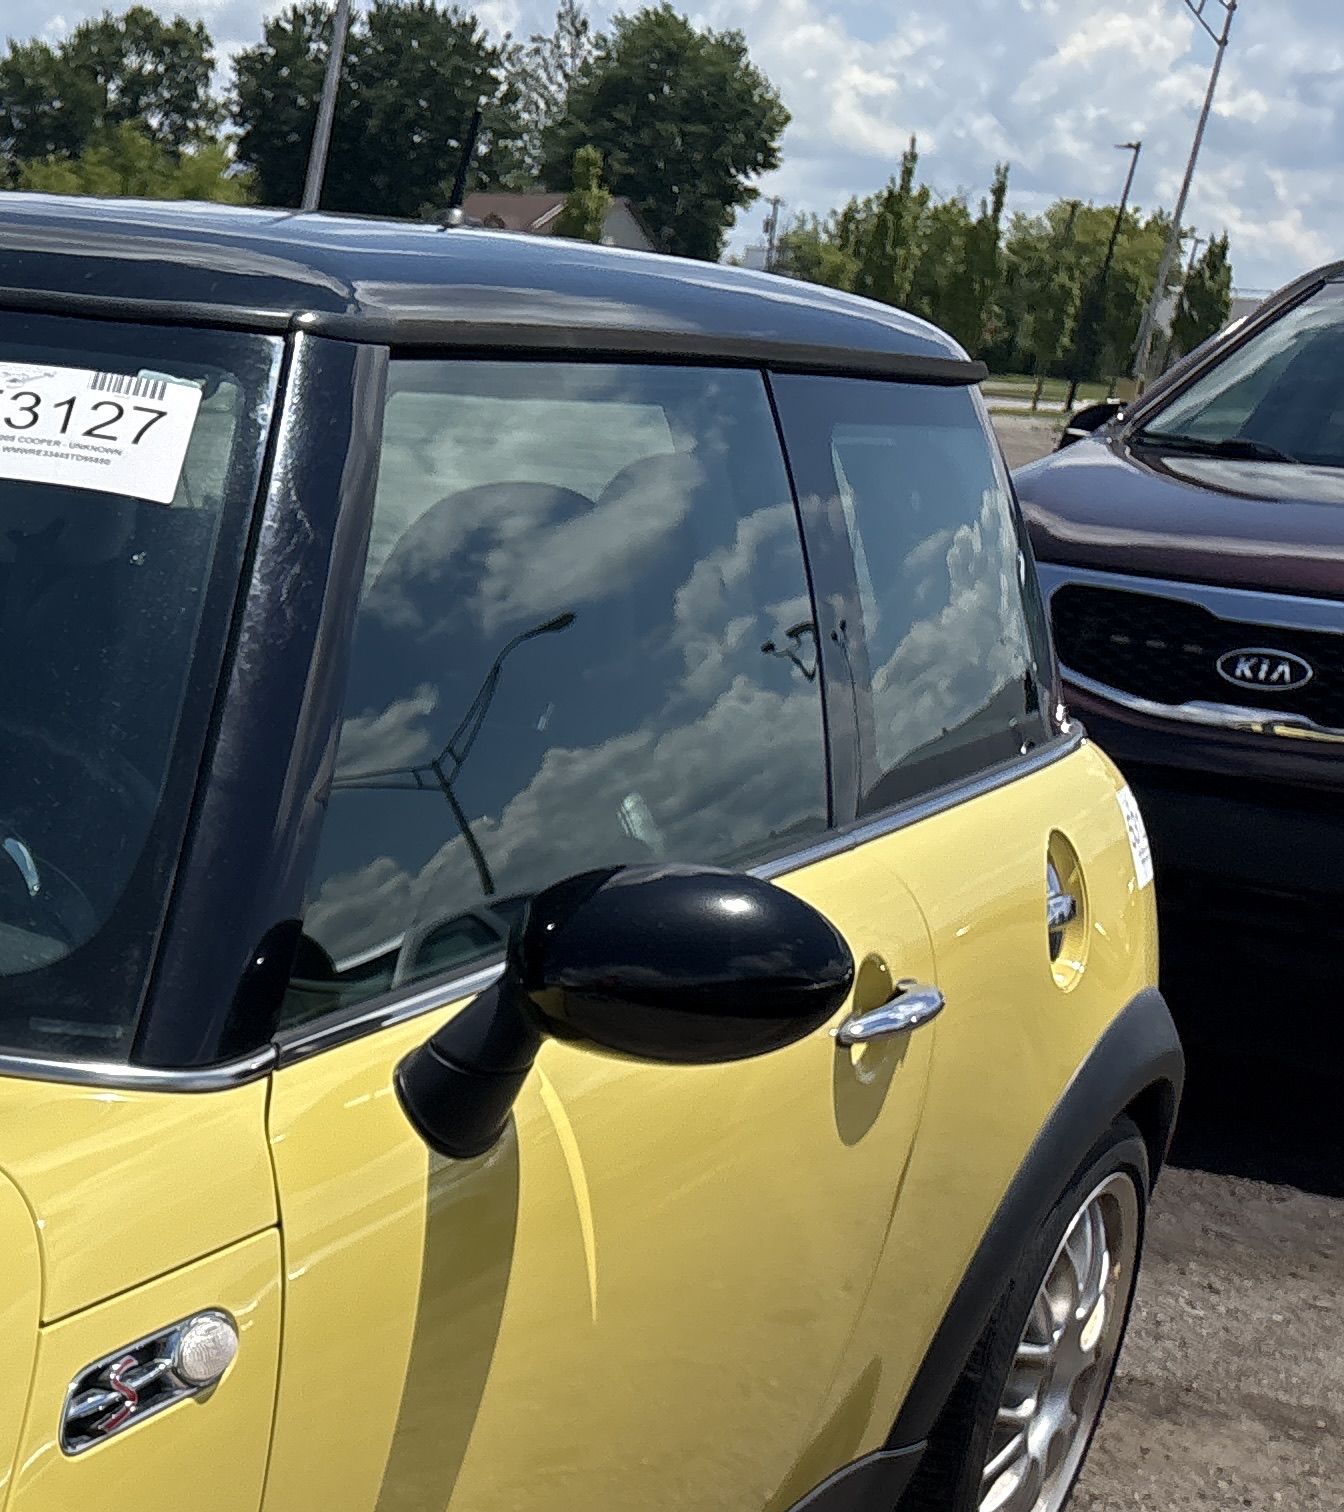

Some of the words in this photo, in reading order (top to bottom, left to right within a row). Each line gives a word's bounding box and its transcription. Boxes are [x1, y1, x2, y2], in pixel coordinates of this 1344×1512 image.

[17, 435, 61, 448] COOPER
[69, 440, 122, 456] UNKNOWN
[1235, 655, 1291, 682] KIA
